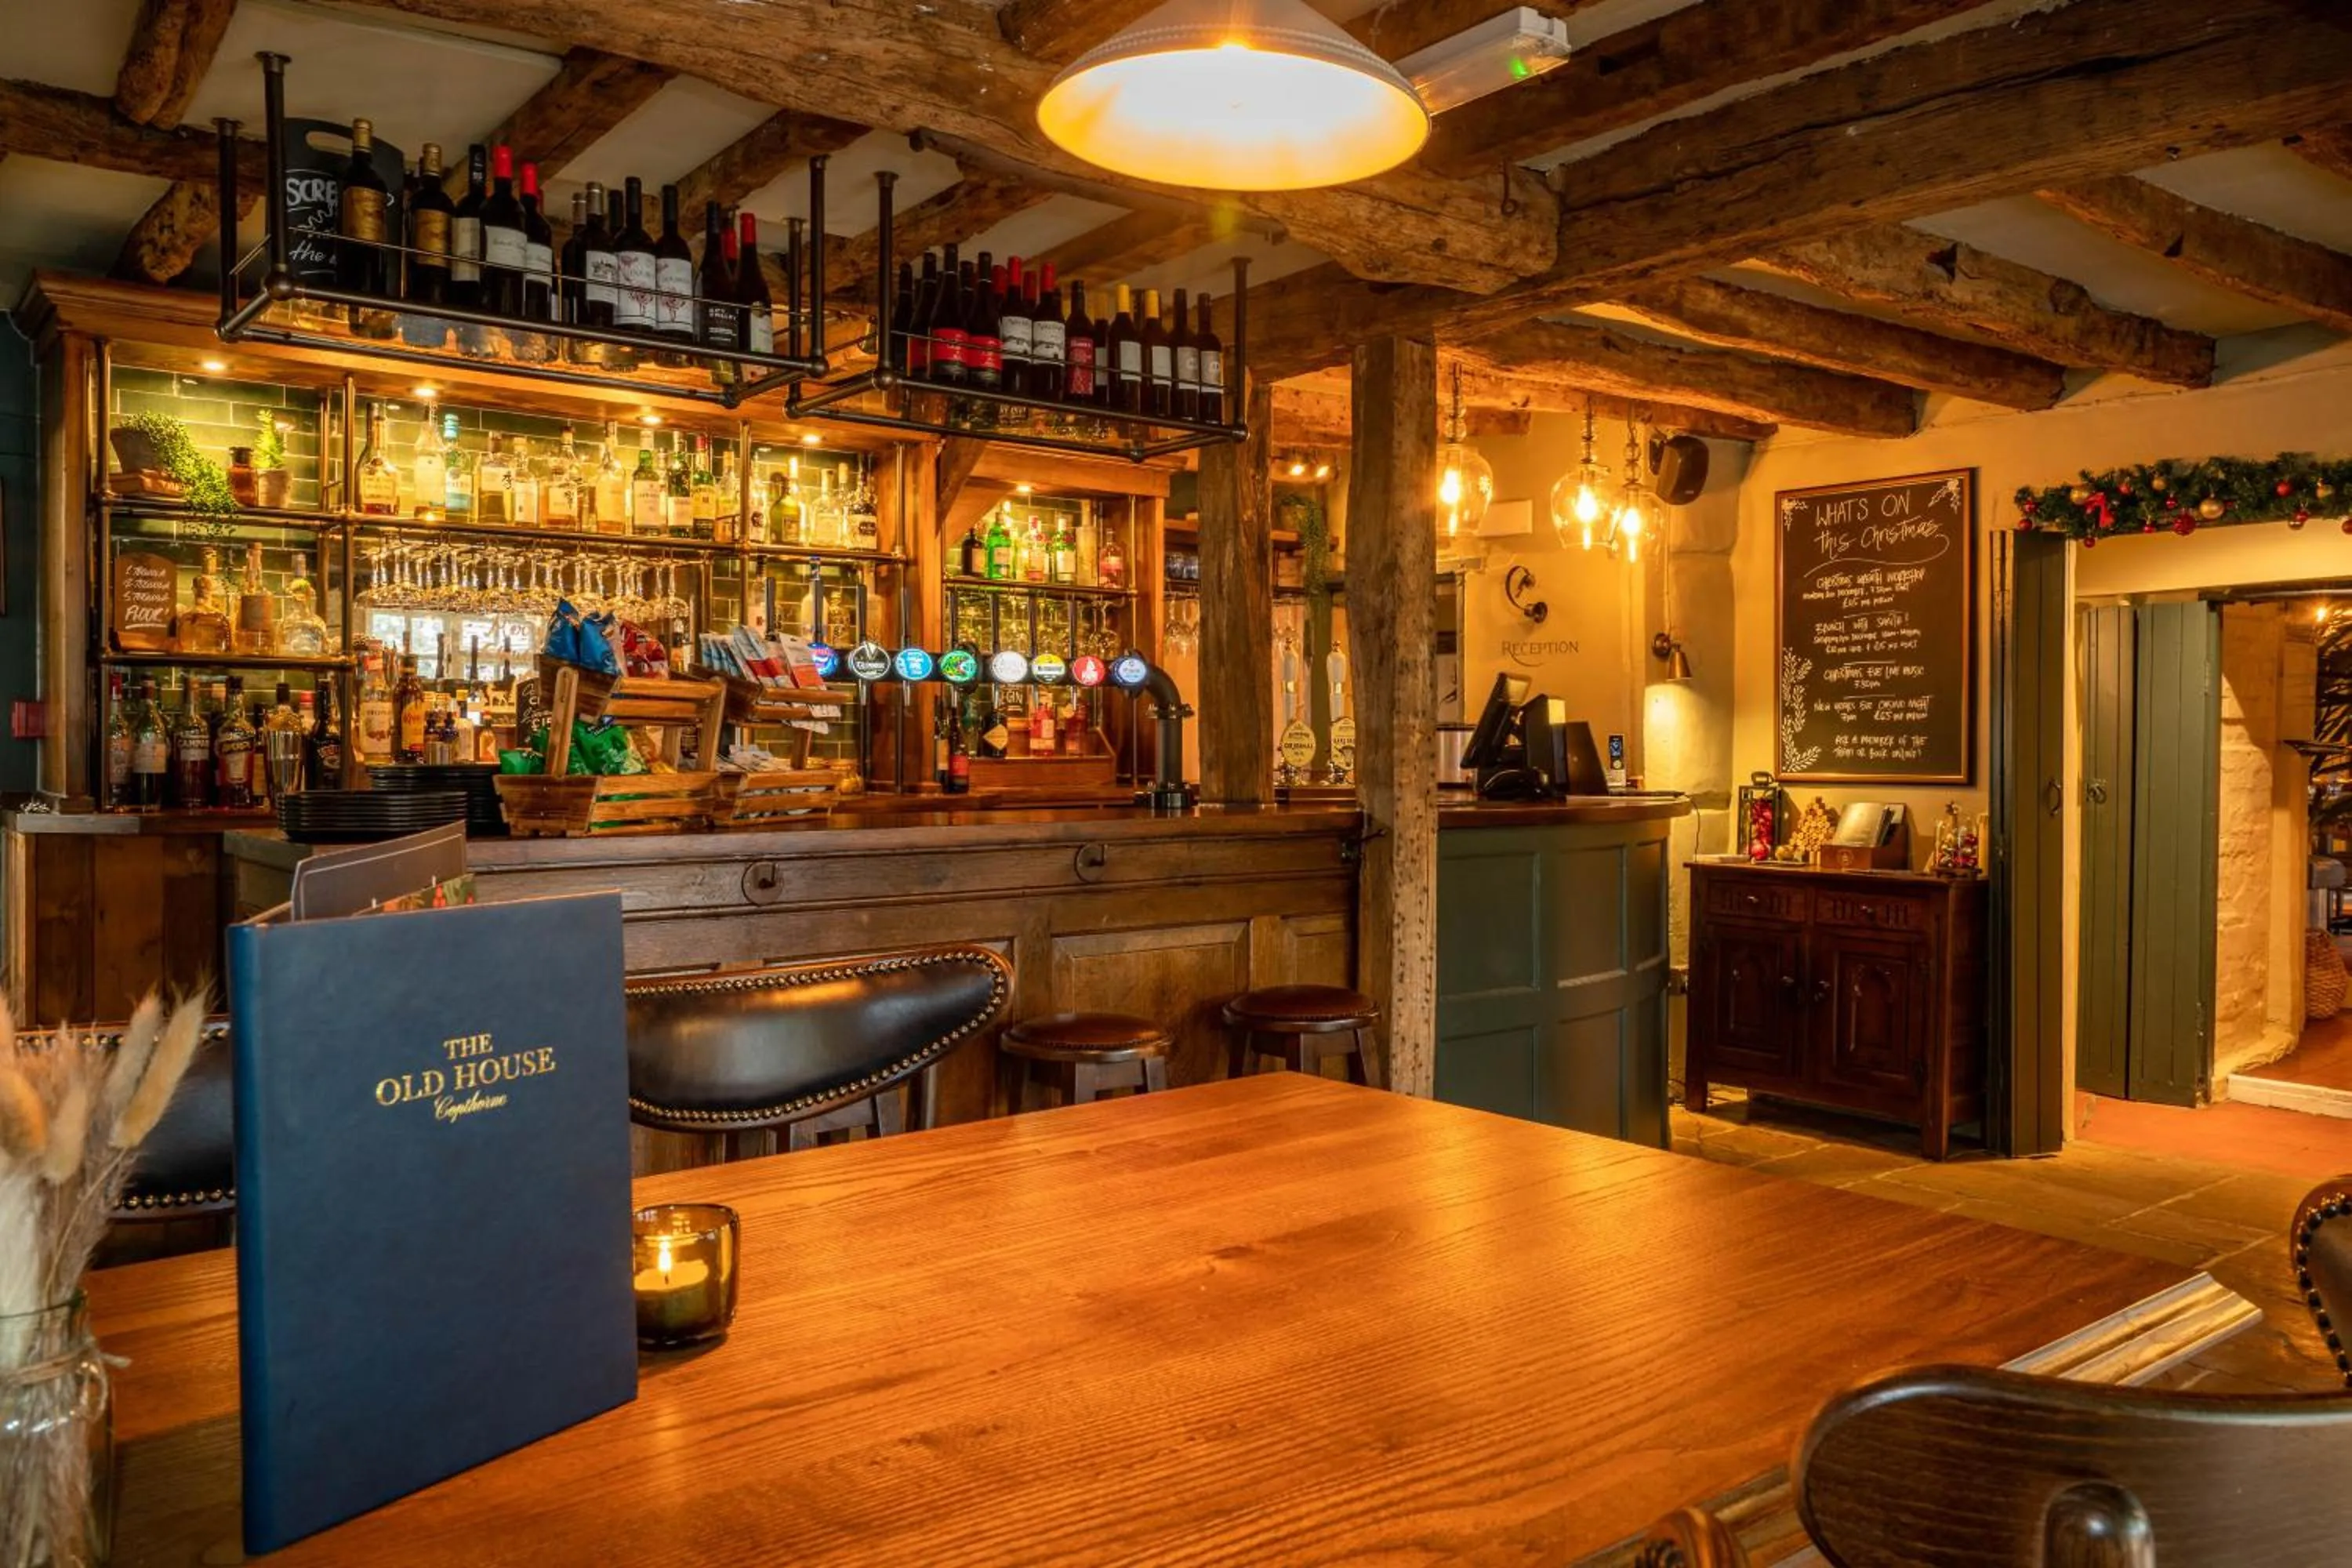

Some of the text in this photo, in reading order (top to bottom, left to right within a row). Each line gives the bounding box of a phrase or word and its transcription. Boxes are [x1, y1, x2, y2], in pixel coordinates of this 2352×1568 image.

[286, 177, 338, 207] SCRE
[1882, 490, 1911, 517] ON
[1813, 515, 1944, 560] this Christmas
[1501, 641, 1580, 662] RECEPTION
[443, 1033, 494, 1060] THE
[375, 1047, 557, 1107] OLD HOUSE
[434, 1090, 509, 1123] Copthorne
